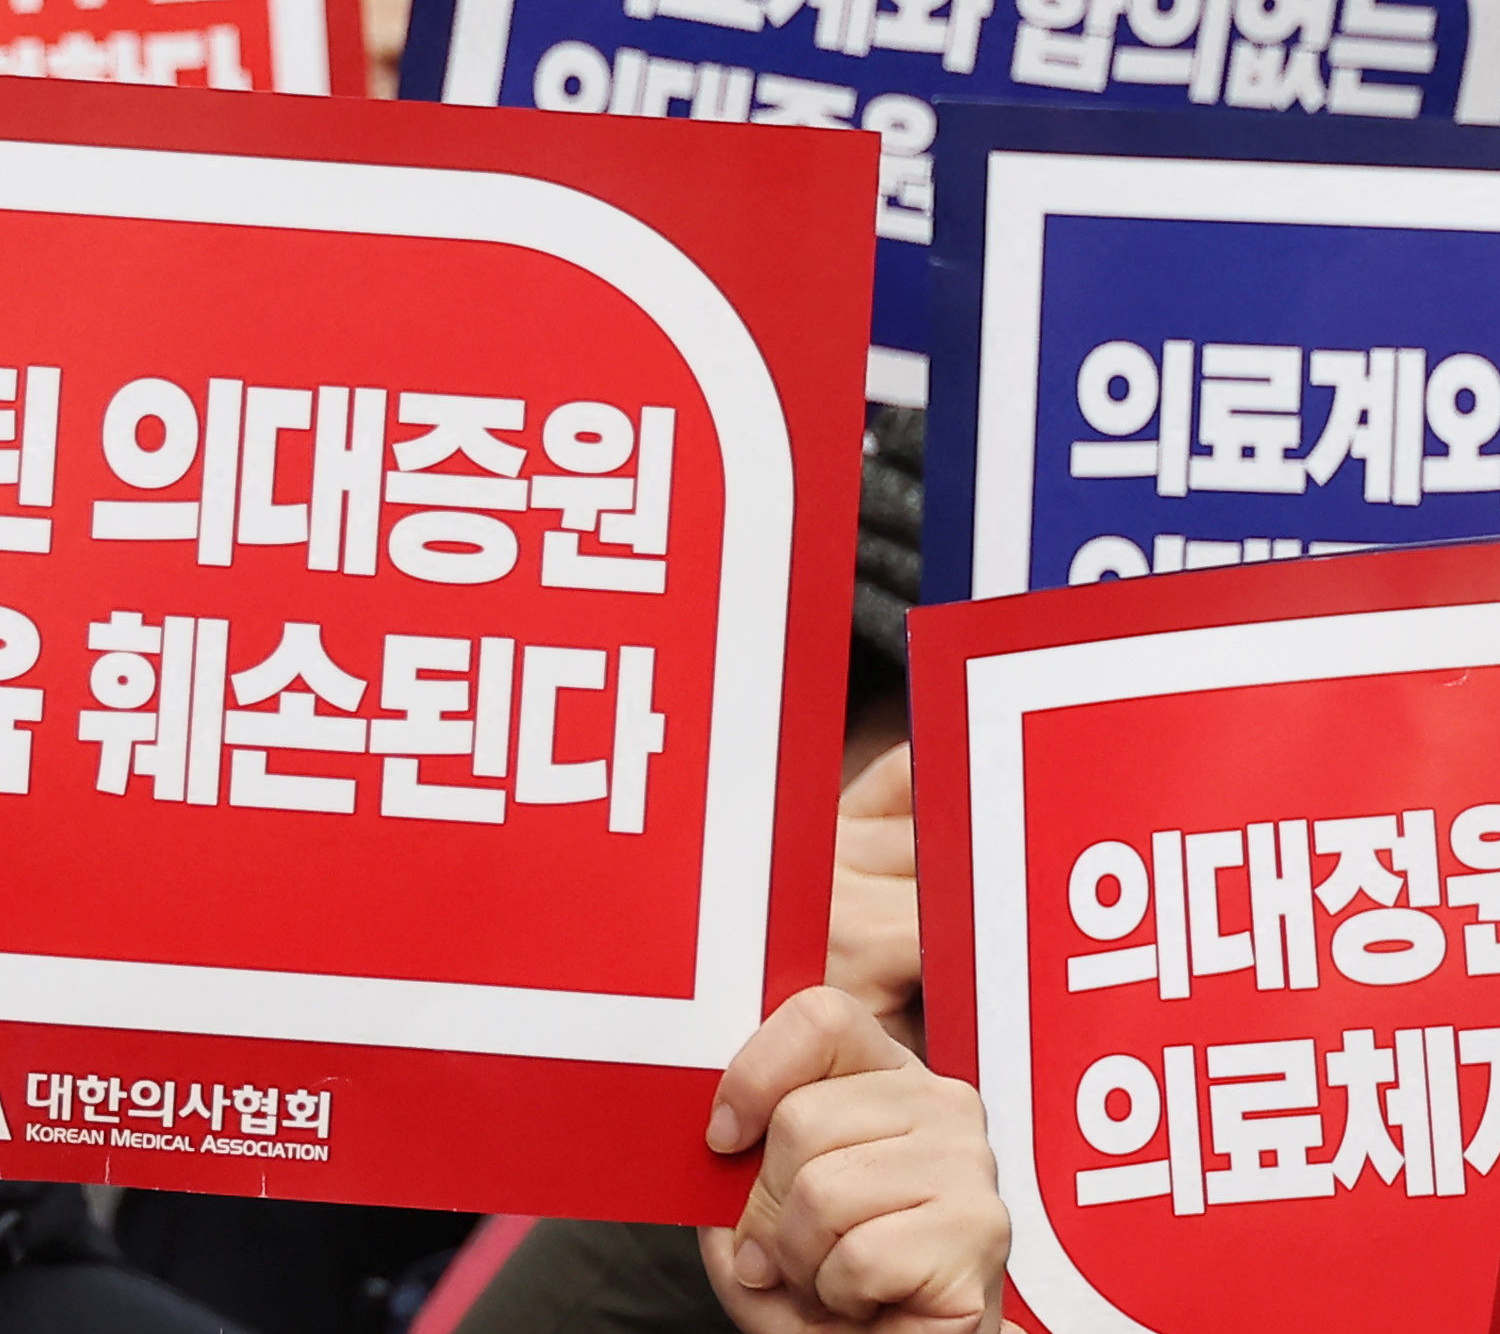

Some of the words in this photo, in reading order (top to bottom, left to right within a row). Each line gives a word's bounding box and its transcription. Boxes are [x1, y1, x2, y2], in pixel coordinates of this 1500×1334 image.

[92, 374, 676, 595] 의대증원
[77, 609, 665, 835] 훼손된다
[26, 1073, 331, 1139] 대한의사협회
